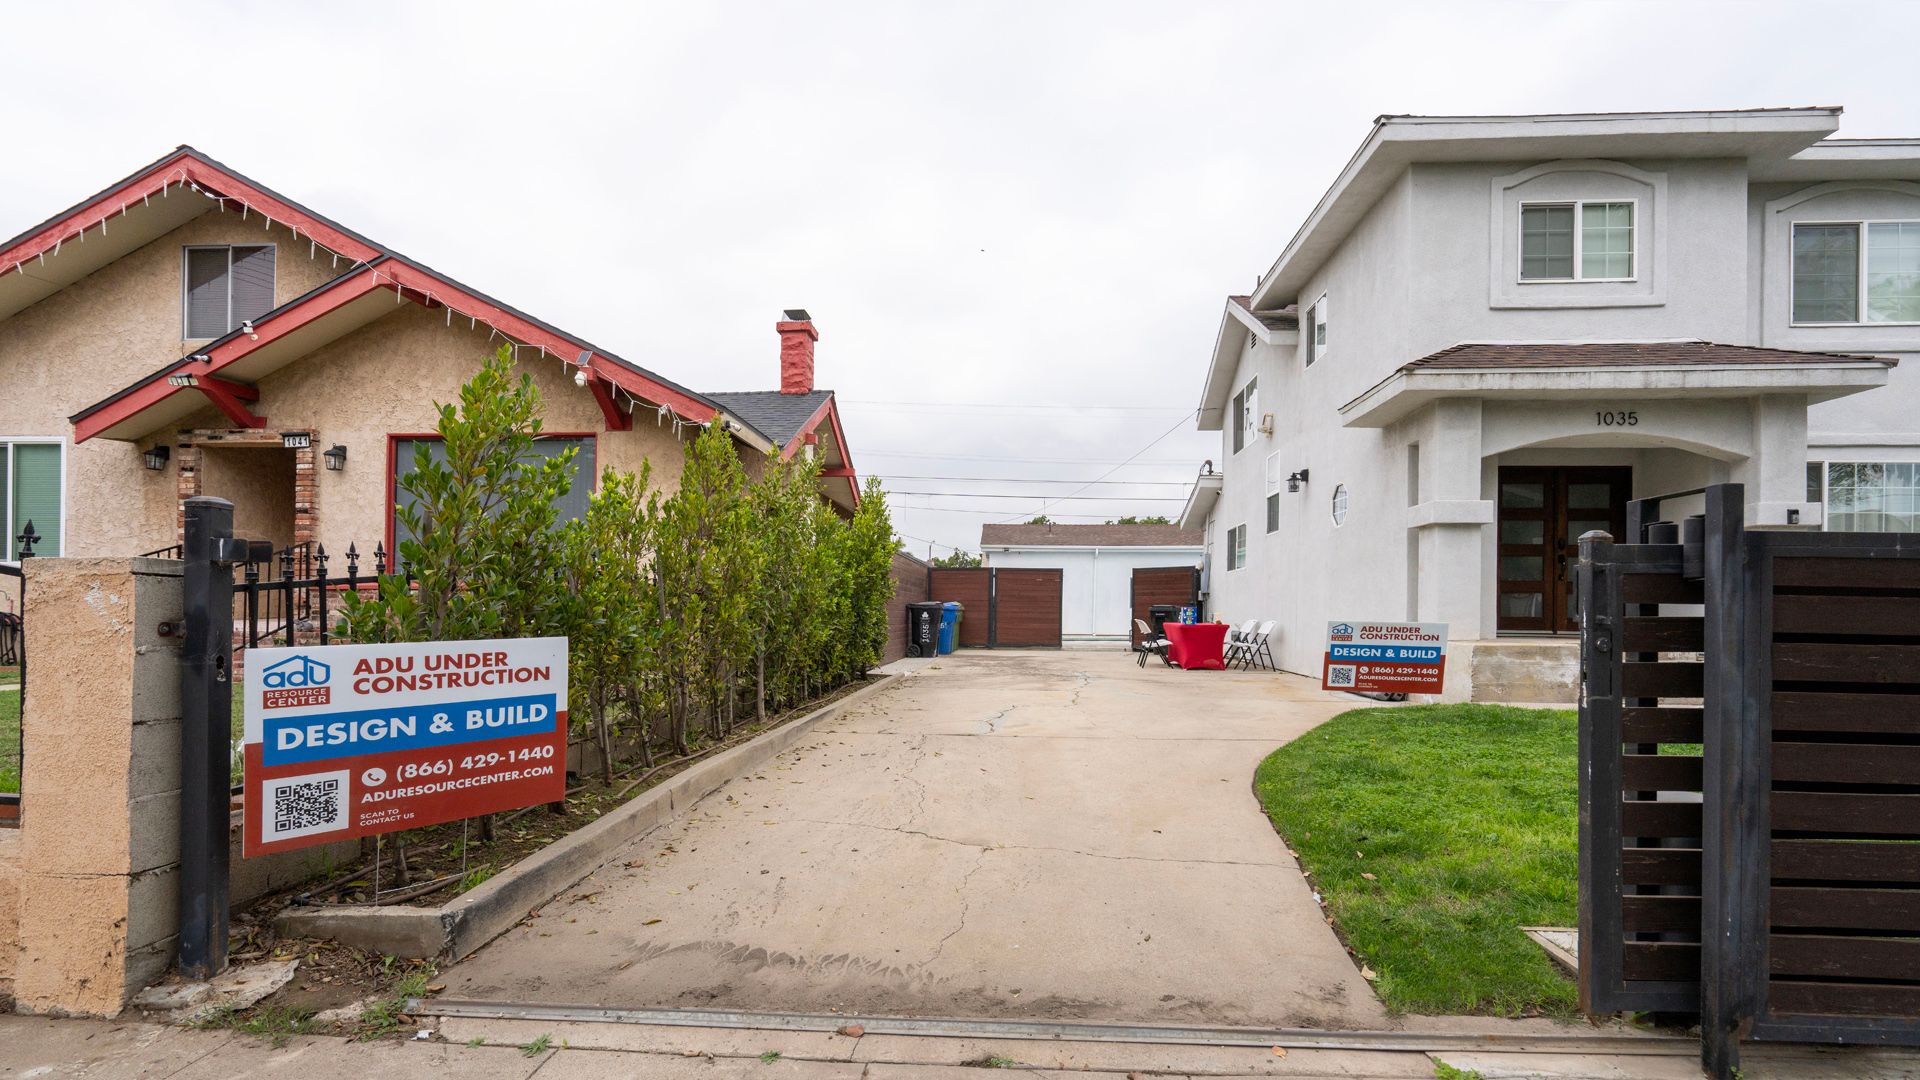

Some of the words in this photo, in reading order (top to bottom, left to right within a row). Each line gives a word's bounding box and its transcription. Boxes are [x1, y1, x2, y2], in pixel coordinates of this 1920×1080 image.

[1596, 411, 1638, 426] 1035
[287, 436, 308, 446] 1041
[1386, 626, 1420, 634] UNDER
[1360, 633, 1440, 641] CONSTRUCTION
[1334, 647, 1381, 657] DESIGN
[1385, 649, 1395, 658] &
[1400, 650, 1437, 659] BUILD
[353, 656, 414, 676] ADU
[424, 651, 509, 672] UNDER
[1371, 666, 1394, 674] (866)
[1396, 667, 1438, 675] 429-1440
[353, 666, 551, 695] CONSTRUCTION
[267, 688, 327, 699] RESOURCE
[267, 695, 327, 707] CENTER
[277, 715, 417, 751] DESIGN
[429, 712, 455, 733] &
[466, 703, 548, 730] BUILD
[396, 759, 454, 783] (866)
[460, 745, 554, 770] 429-1440
[361, 765, 554, 804] ADURESOURCECENTER.COM
[360, 811, 385, 820] SCAN
[360, 815, 402, 826] CONTACT
